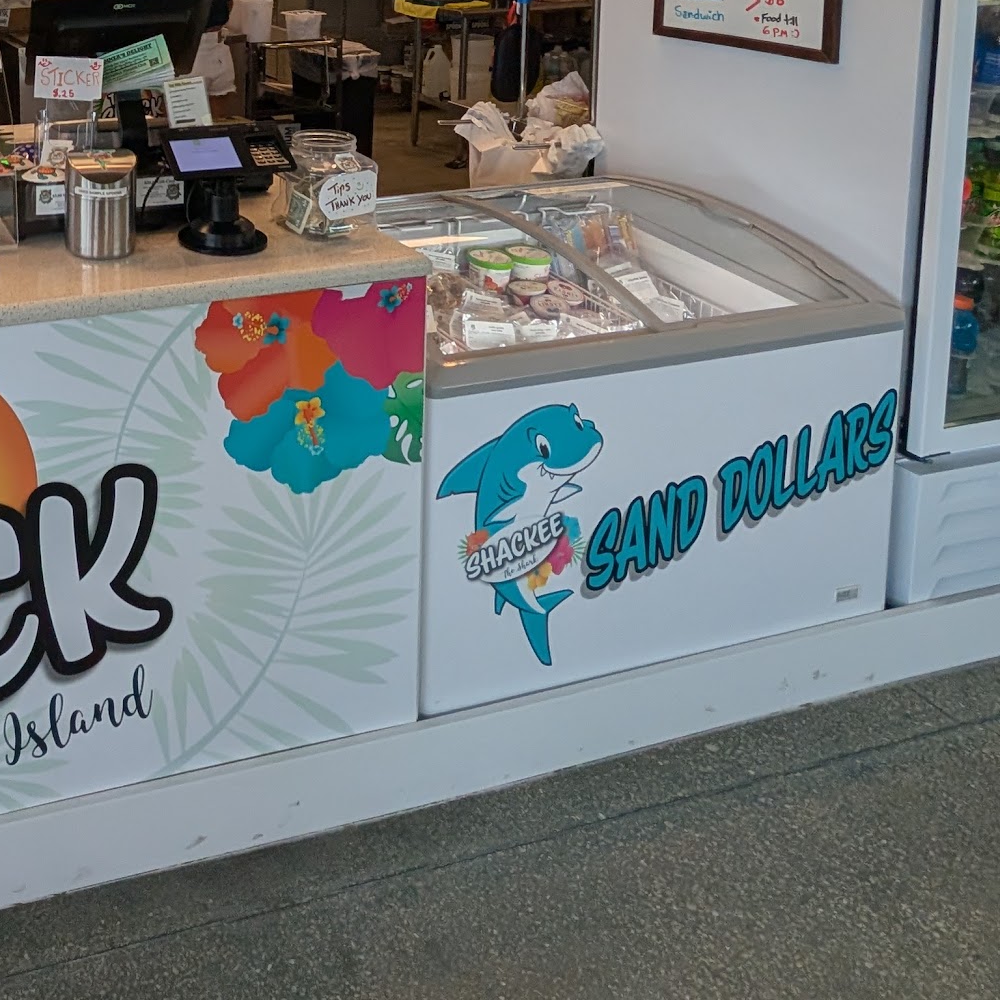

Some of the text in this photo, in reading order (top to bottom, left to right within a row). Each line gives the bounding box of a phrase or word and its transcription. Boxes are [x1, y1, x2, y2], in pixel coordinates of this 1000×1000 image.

[674, 4, 725, 21] Sandwich
[761, 13, 782, 25] Food
[40, 66, 101, 87] STICKER
[327, 182, 351, 197] Tips
[325, 196, 356, 212] THANK
[584, 387, 898, 591] SAND DOLLARS
[465, 511, 565, 580] SHACKEE
[0, 664, 153, 767] Island
